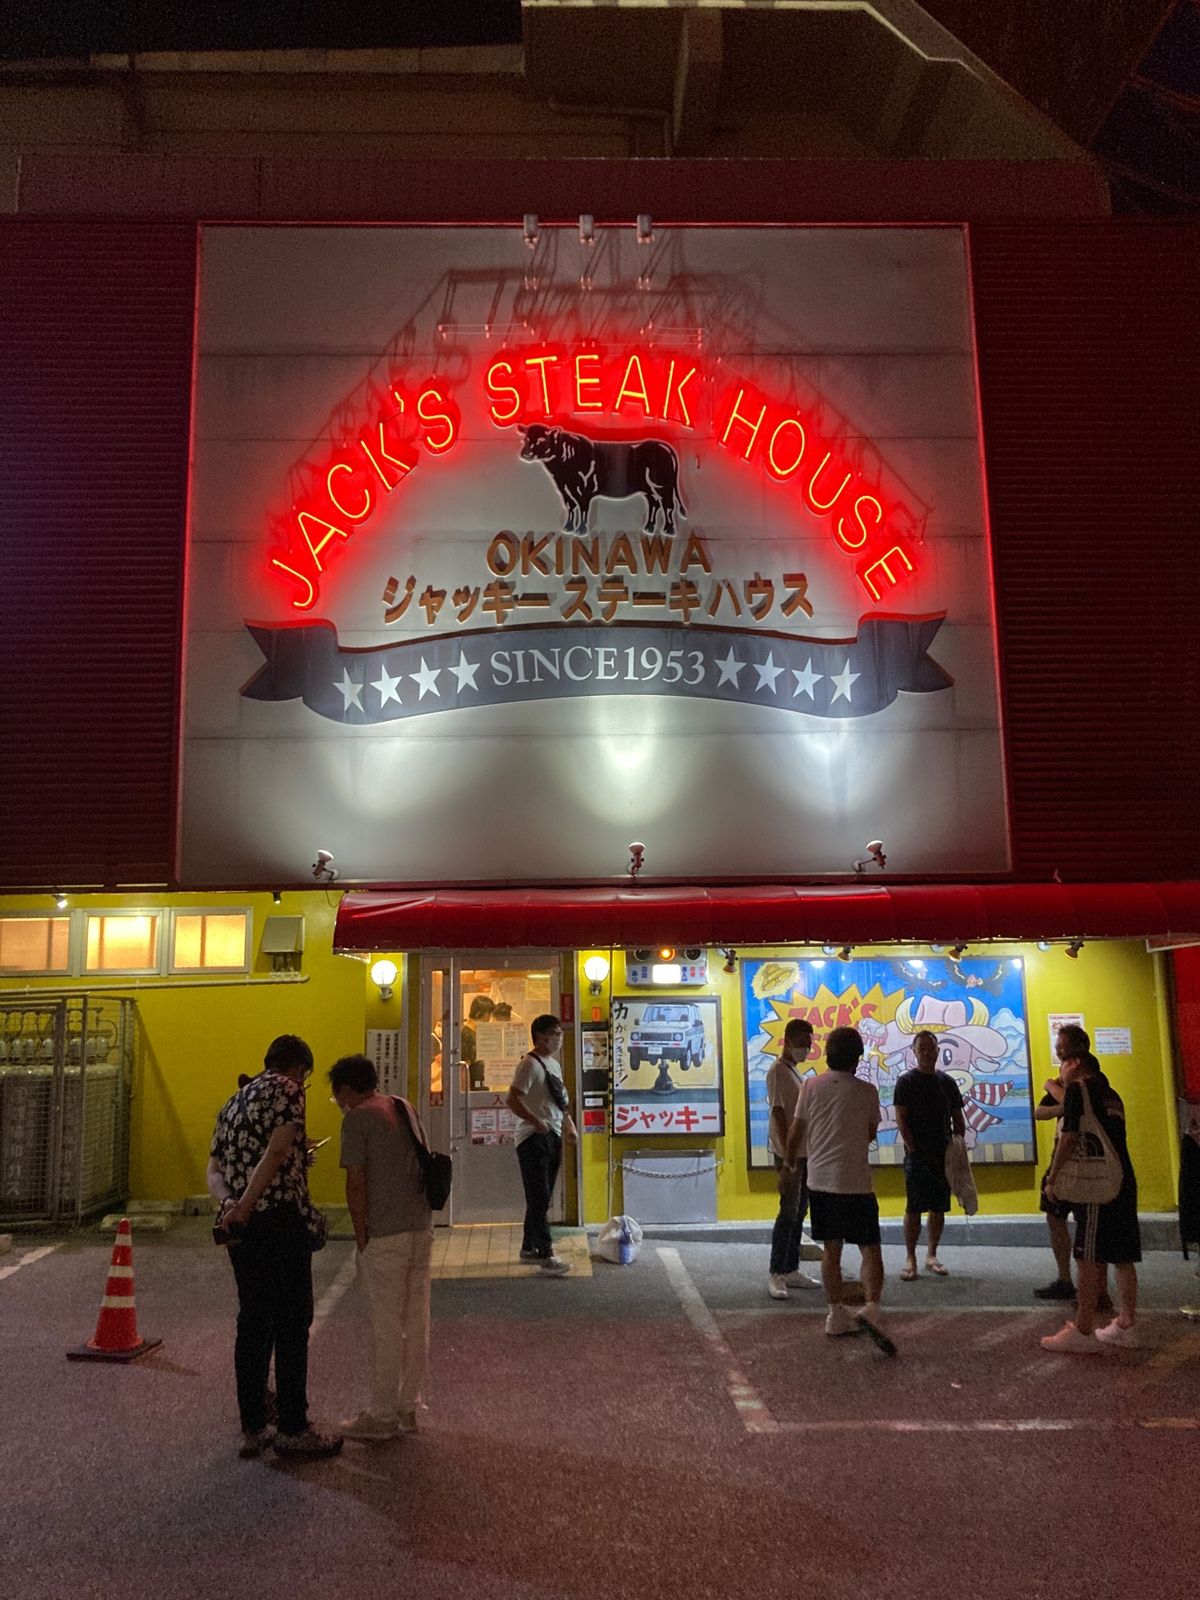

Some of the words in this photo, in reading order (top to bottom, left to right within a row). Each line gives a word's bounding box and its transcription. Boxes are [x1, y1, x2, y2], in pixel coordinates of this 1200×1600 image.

[271, 387, 455, 609] JACK'S
[487, 354, 698, 427] STEAK
[721, 388, 914, 602] HOUSE
[486, 530, 712, 577] OKINAWA
[615, 1105, 718, 1133] ジャッキー
